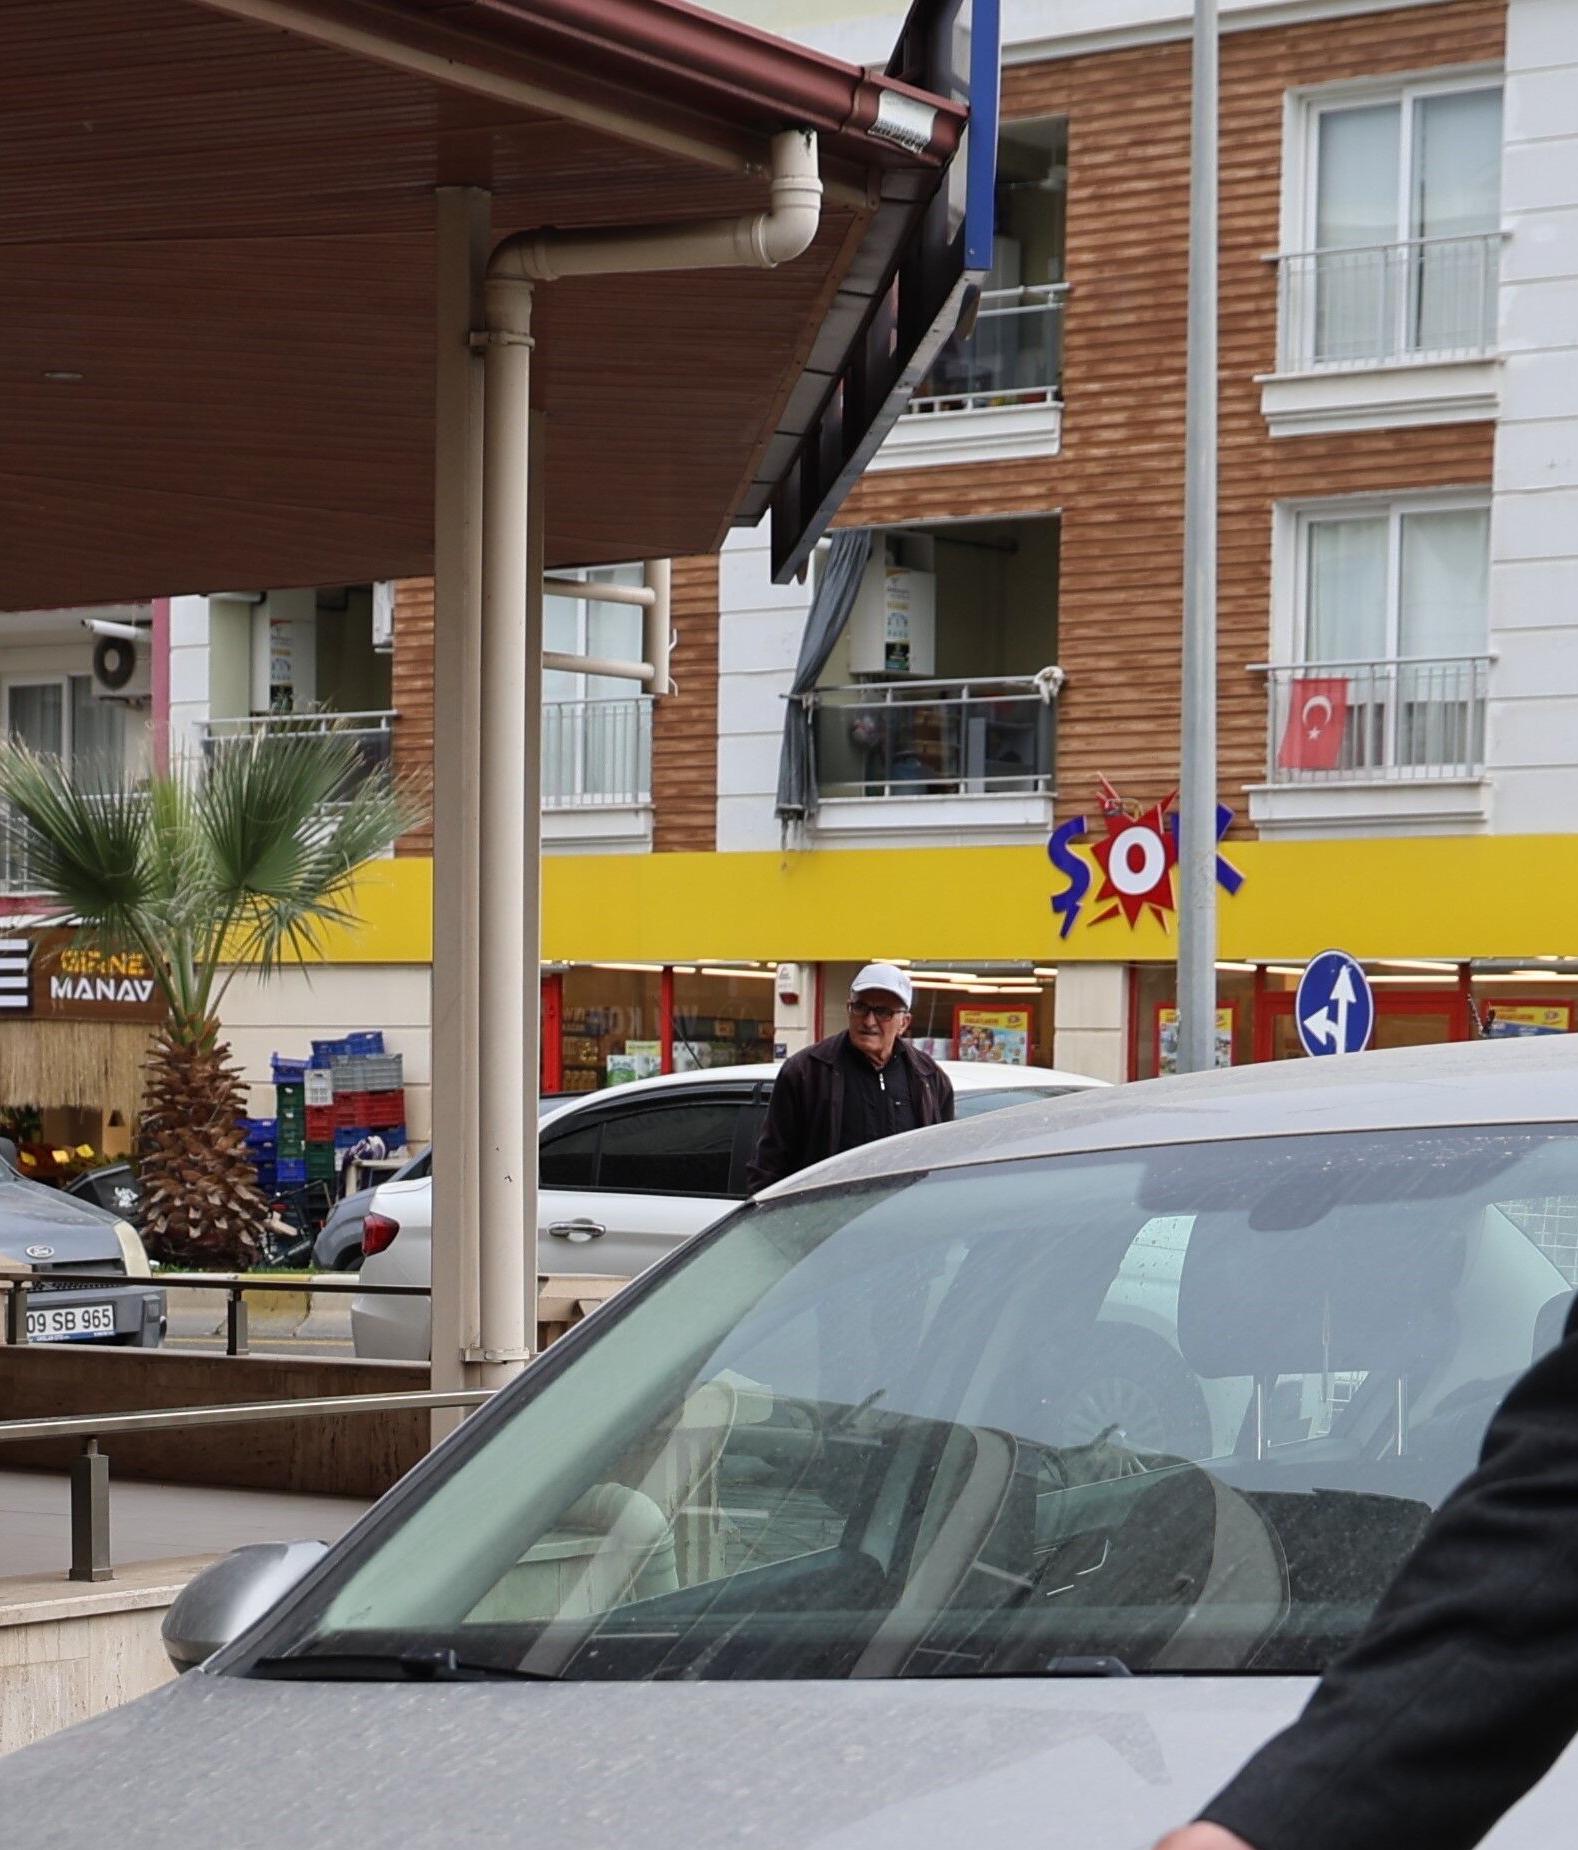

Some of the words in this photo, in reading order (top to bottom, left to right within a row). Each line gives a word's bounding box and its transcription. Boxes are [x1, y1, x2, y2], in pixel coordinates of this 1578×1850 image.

[50, 975, 155, 1003] MANAV
[26, 1313, 47, 1333] 09
[52, 1311, 76, 1332] SB
[81, 1309, 112, 1330] 965
